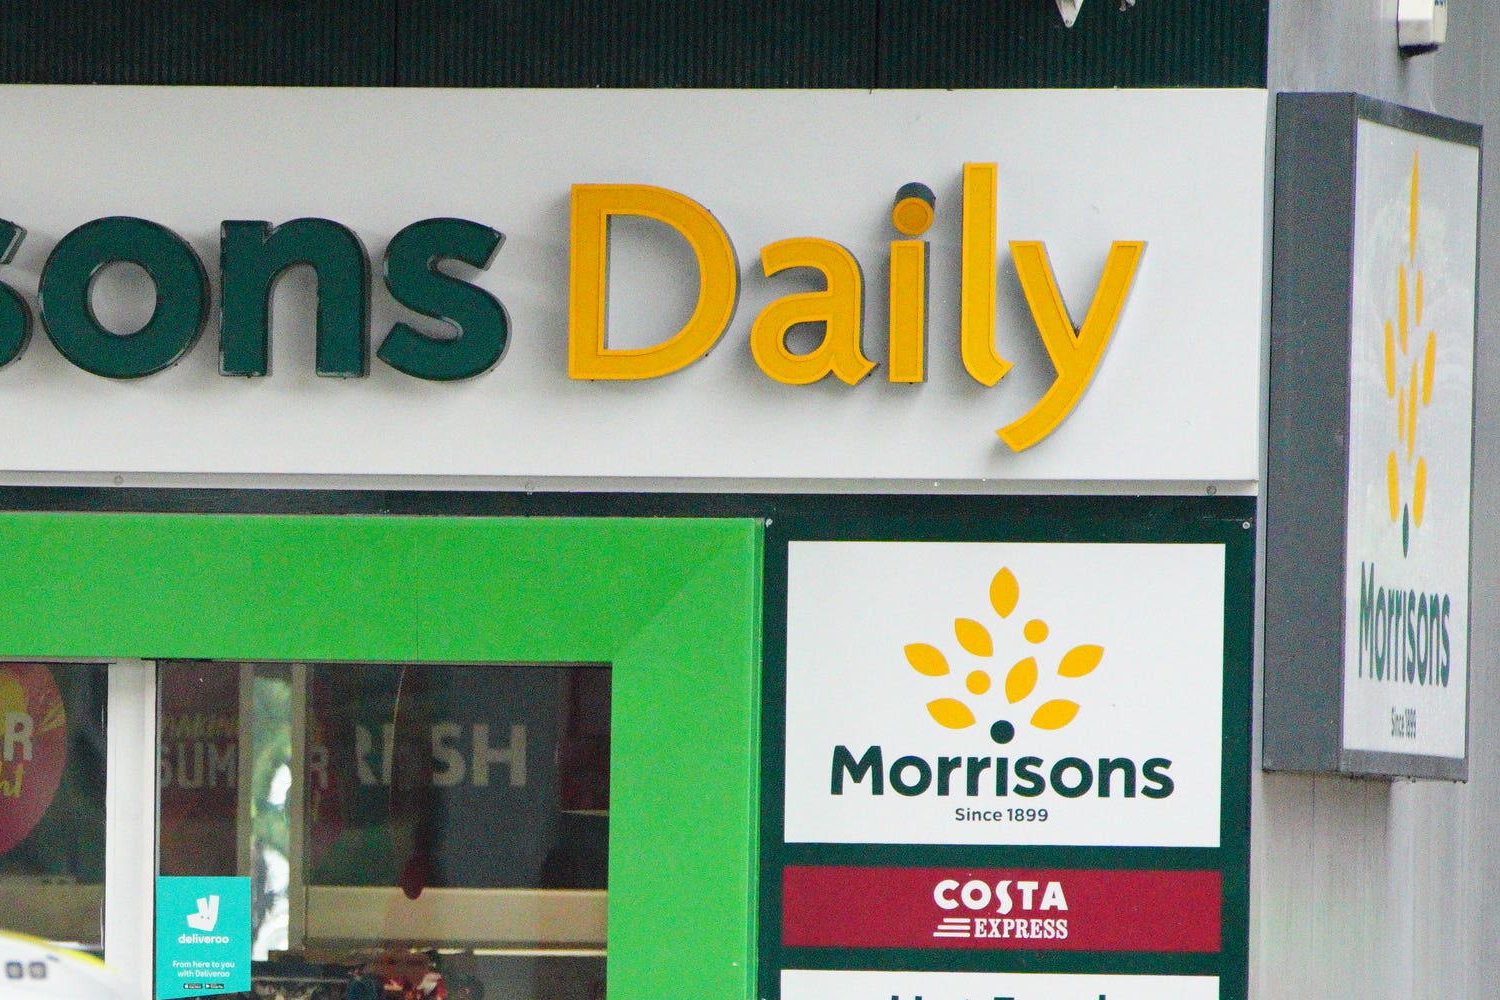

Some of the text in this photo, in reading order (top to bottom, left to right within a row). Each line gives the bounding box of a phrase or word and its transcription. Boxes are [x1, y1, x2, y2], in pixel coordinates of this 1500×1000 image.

[567, 162, 1146, 454] Daily
[1359, 560, 1451, 688] Morrisons
[829, 720, 1176, 799] Morrisons
[954, 807, 1049, 824] Since 1899
[933, 879, 1069, 915] COSTA
[178, 933, 230, 944] deliveroo
[974, 918, 1069, 940] EXPRESS
[172, 960, 235, 971] From here to you
[178, 969, 231, 978] with Deliveroo
